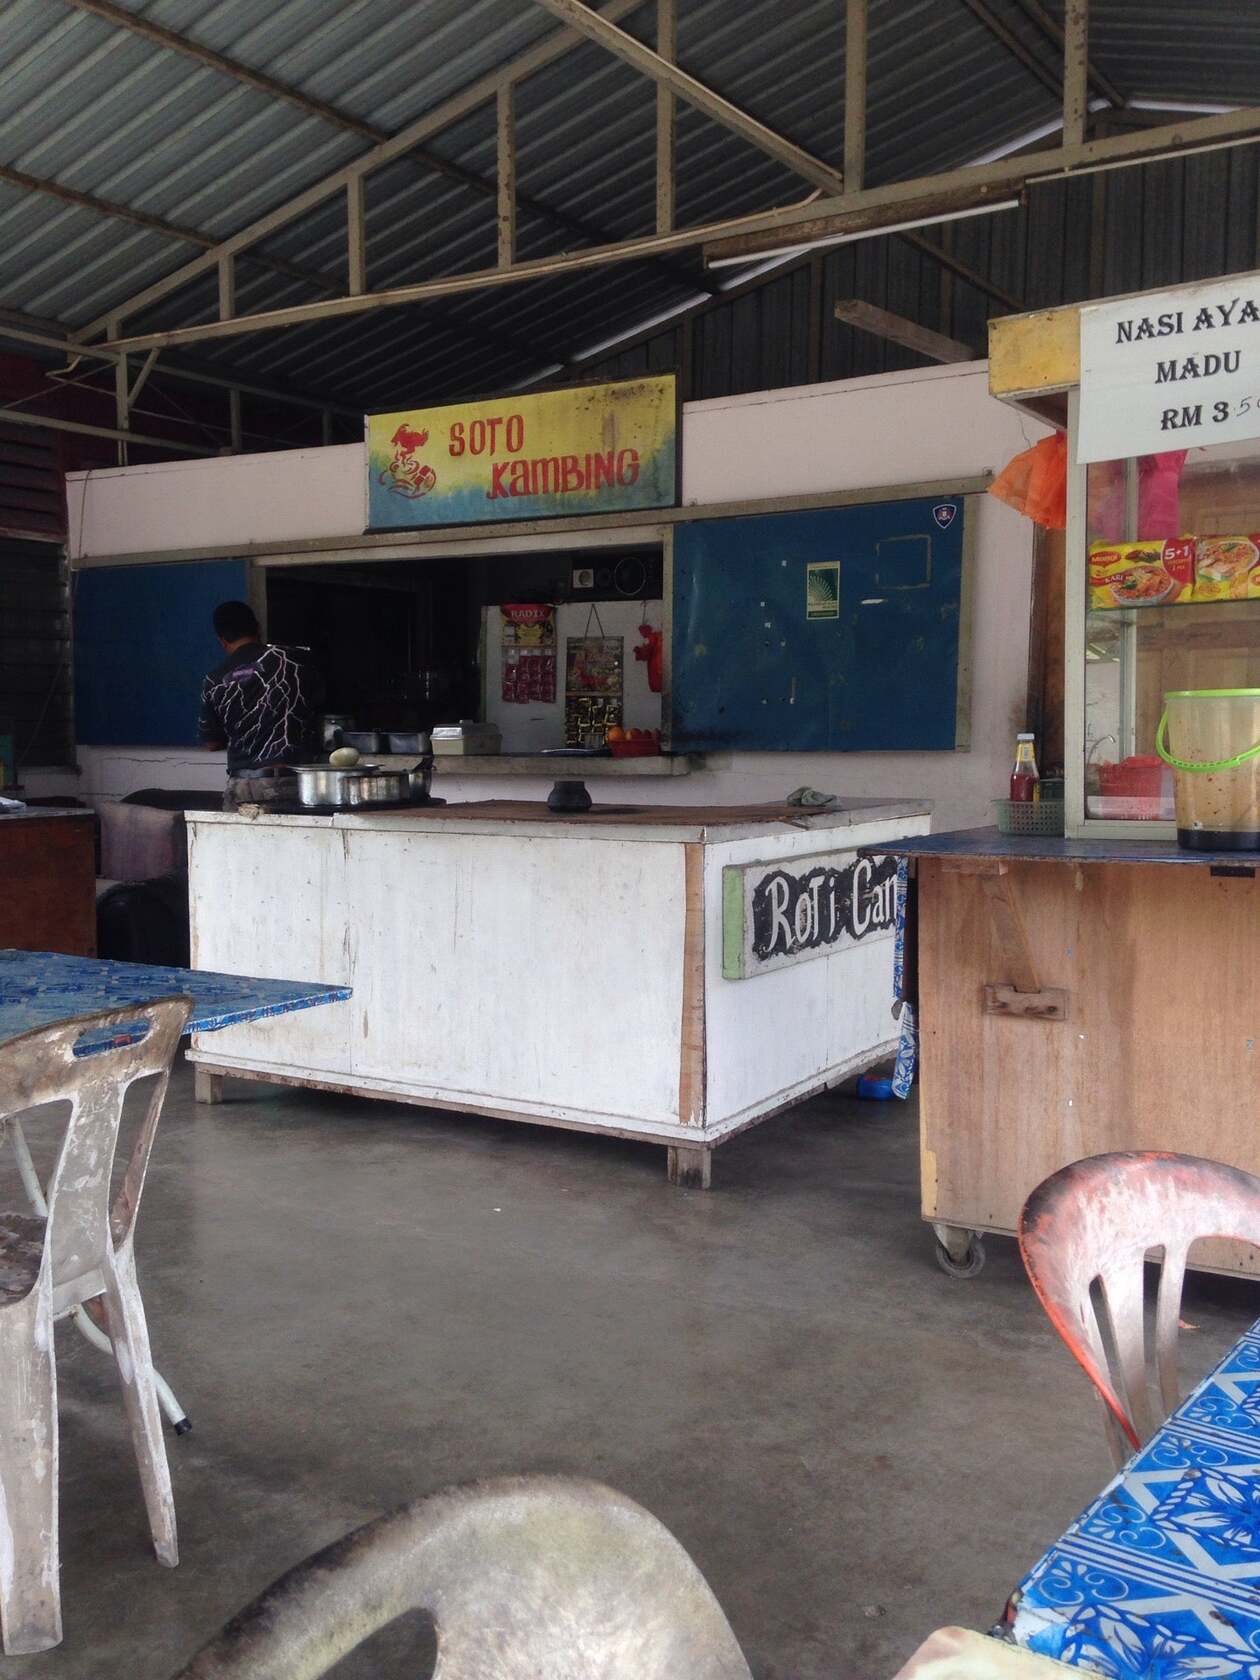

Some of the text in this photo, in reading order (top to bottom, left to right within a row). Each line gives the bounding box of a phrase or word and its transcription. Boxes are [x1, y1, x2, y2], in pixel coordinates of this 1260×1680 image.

[1116, 311, 1183, 344] NASI
[1155, 350, 1241, 384] MADU
[1160, 404, 1203, 431] RM
[448, 414, 525, 457] SOTO
